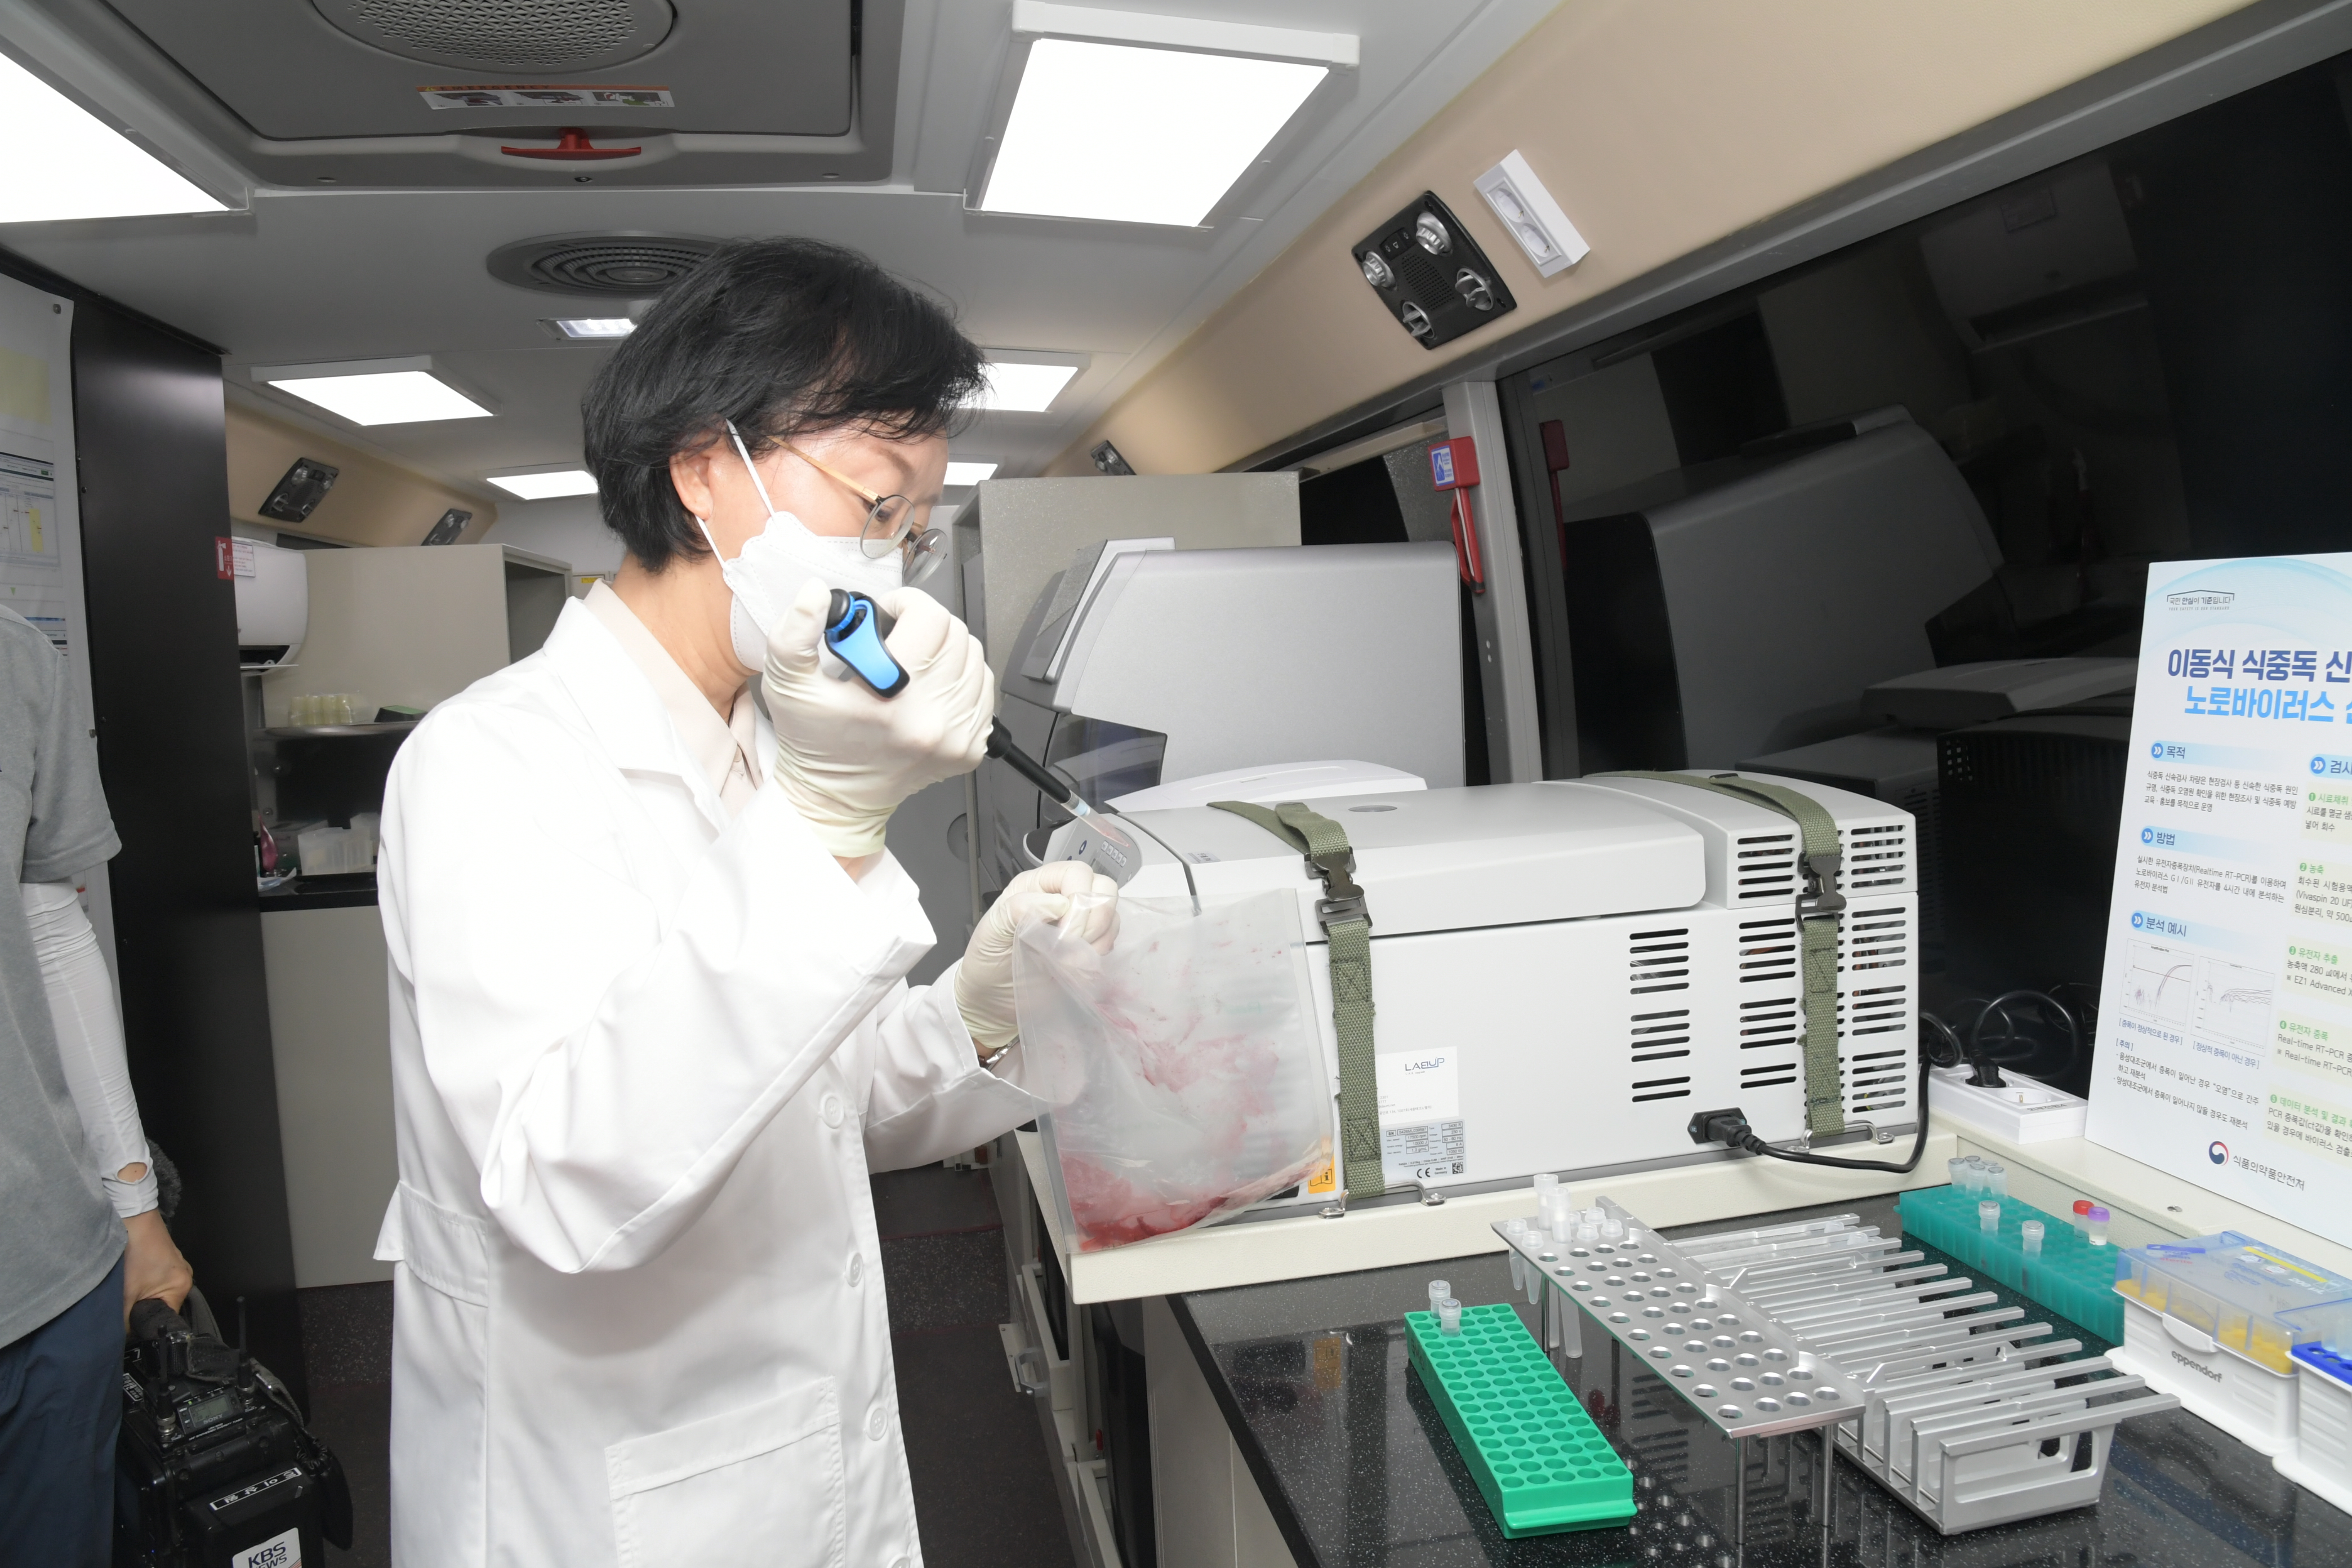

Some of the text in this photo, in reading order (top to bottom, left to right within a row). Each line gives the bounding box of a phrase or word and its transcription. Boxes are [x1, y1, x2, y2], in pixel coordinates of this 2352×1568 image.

[2168, 649, 2235, 679] 이동식
[2242, 650, 2318, 682] 식중독
[2185, 685, 2335, 723] 노로바이러스
[2167, 746, 2185, 759] 목적
[2147, 770, 2298, 795] 식중독 신속검사 차량은 현장검사 등 신속한 식중독 원인
[2144, 795, 2213, 812] 교육 홍보를 목적으로 운영
[2146, 783, 2297, 809] 규명, 식중독 오염원 확인을 위한 현장조사 및 식중독 예방
[2318, 793, 2349, 805] 시료채취
[2306, 806, 2342, 819] 시료를 멸균
[2305, 820, 2335, 832] 넣어 회수
[2157, 832, 2175, 845] 방법
[2155, 858, 2222, 877] 유전자증폭장치(Realtime
[2225, 871, 2258, 884] RT-PCR)를
[2260, 877, 2287, 889] 이용하여
[2309, 864, 2324, 875] 농축
[2135, 880, 2168, 894] 유전자 분석법
[2136, 867, 2168, 880] 노로바이러스
[2197, 879, 2221, 891] 유전자를
[2223, 884, 2240, 895] 4시간
[2243, 888, 2256, 897] 내에
[2258, 890, 2284, 903] 분석하는
[2298, 876, 2319, 888] 회수된
[2296, 889, 2327, 903] (Vivaspin
[2330, 896, 2340, 905] 20
[2294, 903, 2334, 919] 원심분리, 약
[2146, 917, 2187, 937] 분석 예시
[2298, 948, 2338, 965] 유전자 추출
[2287, 959, 2324, 975] 농축액 280
[2294, 975, 2346, 995] EZ1 Advanced
[2122, 1019, 2180, 1044] 증폭이 정상적으로 된 경우
[2289, 1023, 2328, 1041] 유전자 증폭
[2119, 1040, 2130, 1050] 주의
[2196, 1042, 2256, 1068] 정상적 증폭이 아닌 경우
[2278, 1034, 2313, 1051] Real-time
[2315, 1044, 2344, 1059] RT-PCR
[2285, 1050, 2321, 1067] Real-time
[2118, 1064, 2146, 1081] 하고 재분석
[2119, 1052, 2157, 1072] 음성대조군에서
[2159, 1066, 2176, 1078] 증폭이
[2179, 1072, 2196, 1085] 일어난
[2198, 1079, 2210, 1089] 경우
[2246, 1094, 2259, 1106] 간주
[2117, 1076, 2248, 1130] 양성대조군에서 증폭이 일어나지 않을 경우도 재분석
[2280, 1097, 2301, 1112] 데이터
[2304, 1104, 2318, 1117] 분석
[2321, 1111, 2328, 1121] 및
[2332, 1113, 2346, 1126] 결과
[2269, 1107, 2283, 1119] PCR
[2285, 1113, 2332, 1136] 증폭값(ct값)을
[2267, 1121, 2333, 1151] 있을 경우에 바이러스
[2233, 1155, 2305, 1191] 식품의약품안전처
[2171, 1351, 2222, 1383] eppendorf
[203, 1414, 223, 1424] SONY
[248, 1541, 286, 1568] KBS
